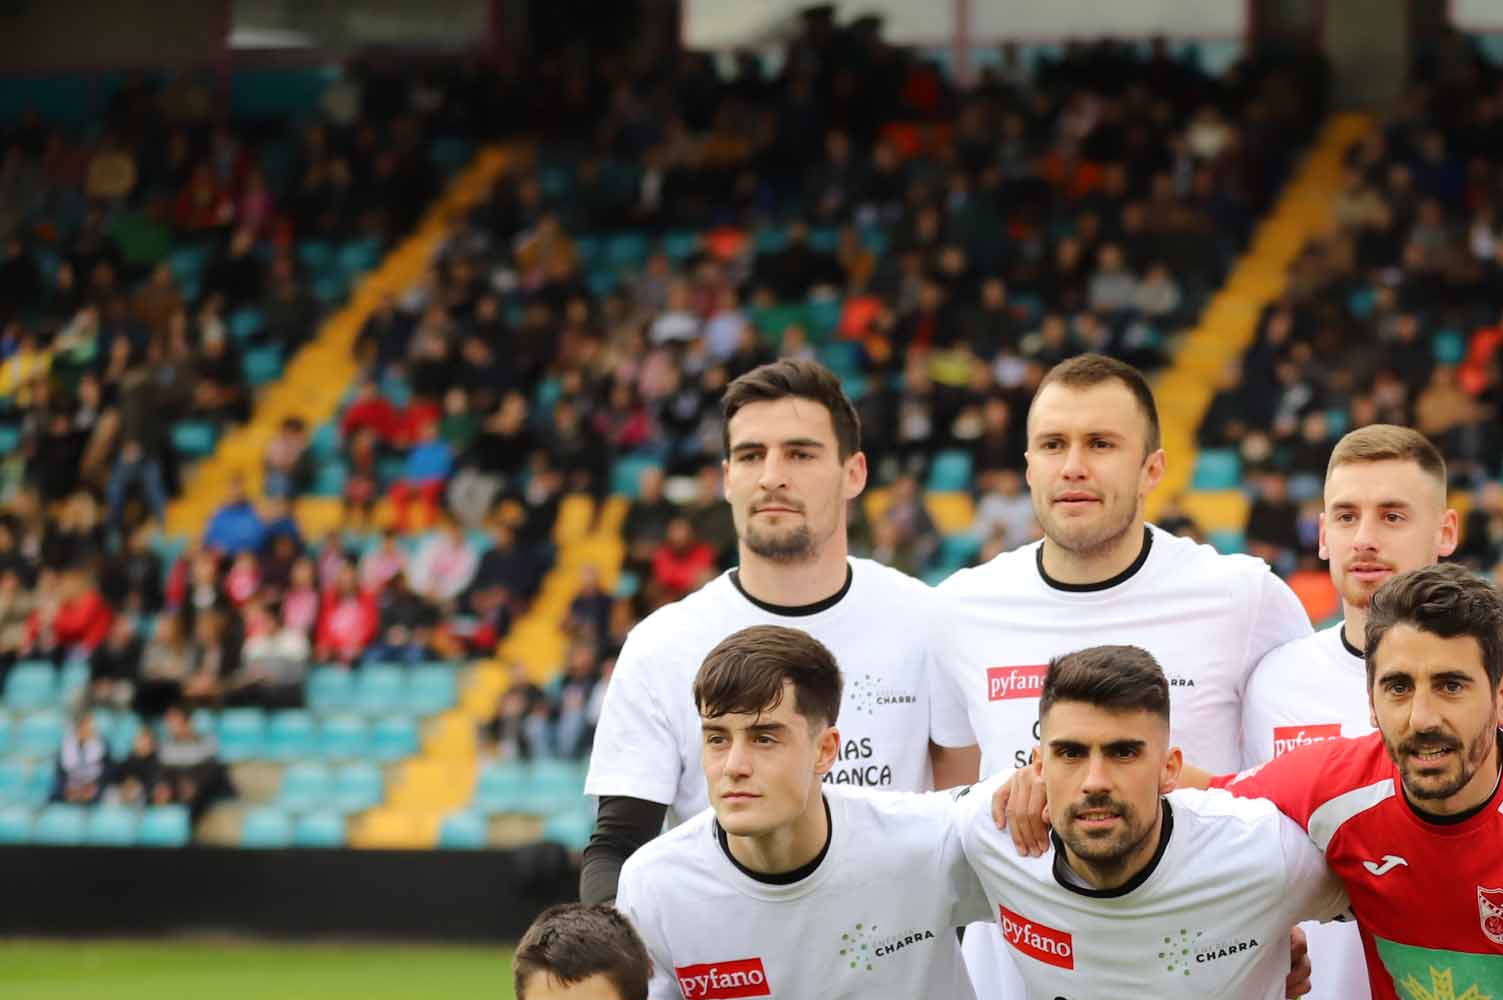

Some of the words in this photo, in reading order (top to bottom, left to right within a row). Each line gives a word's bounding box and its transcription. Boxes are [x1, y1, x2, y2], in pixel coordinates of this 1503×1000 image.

[991, 670, 1046, 693] pyfan
[1171, 679, 1194, 687] RRA
[876, 695, 917, 705] CHARRA
[822, 765, 892, 785] MANCA
[875, 930, 934, 957] CHARRA
[1002, 918, 1071, 957] pyfano
[1196, 939, 1259, 963] CHARRA
[680, 968, 763, 997] pyfano
